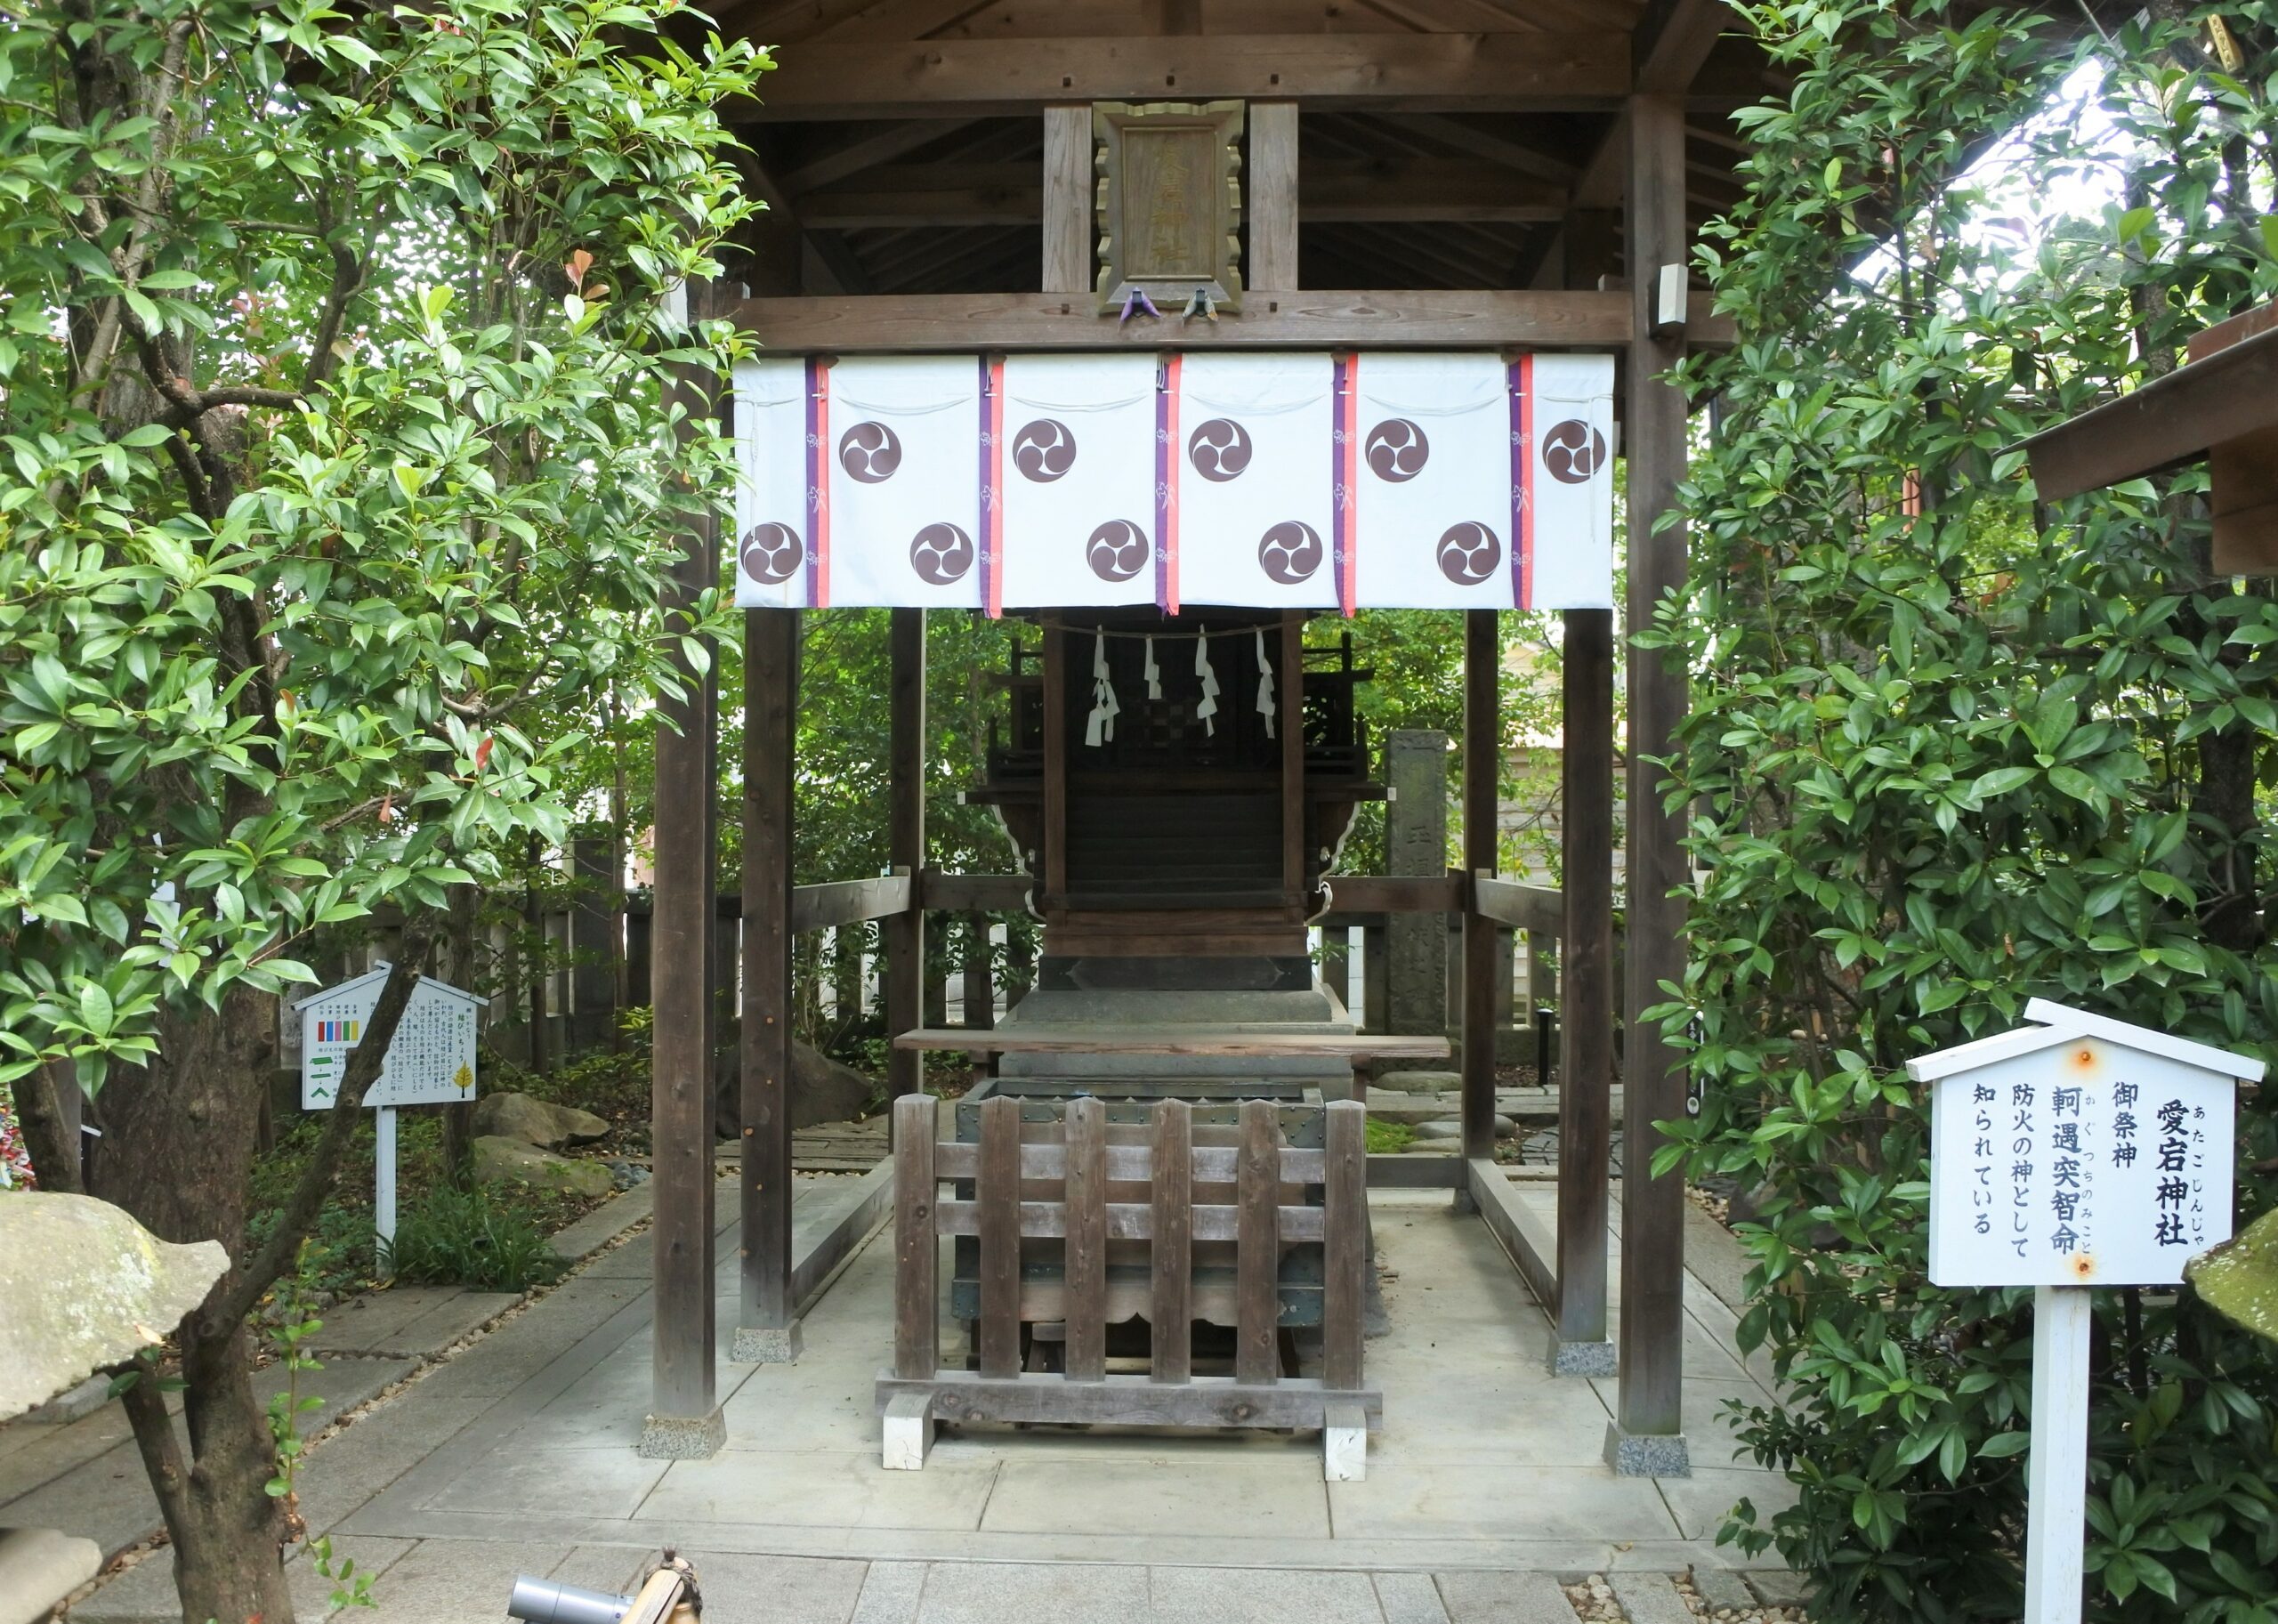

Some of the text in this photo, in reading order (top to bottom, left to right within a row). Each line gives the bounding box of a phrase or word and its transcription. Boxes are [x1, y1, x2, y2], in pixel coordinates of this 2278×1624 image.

[1972, 1083, 1996, 1235] 知られている
[2009, 1084, 2036, 1257] 防火の神として
[2049, 1086, 2083, 1256] 軻遇突智命
[2080, 1095, 2096, 1255] かぐつちのみこと
[2110, 1081, 2139, 1169] 御祭神
[2153, 1098, 2191, 1248] 愛宕神社
[2190, 1104, 2206, 1247] あたごじんじゃ
